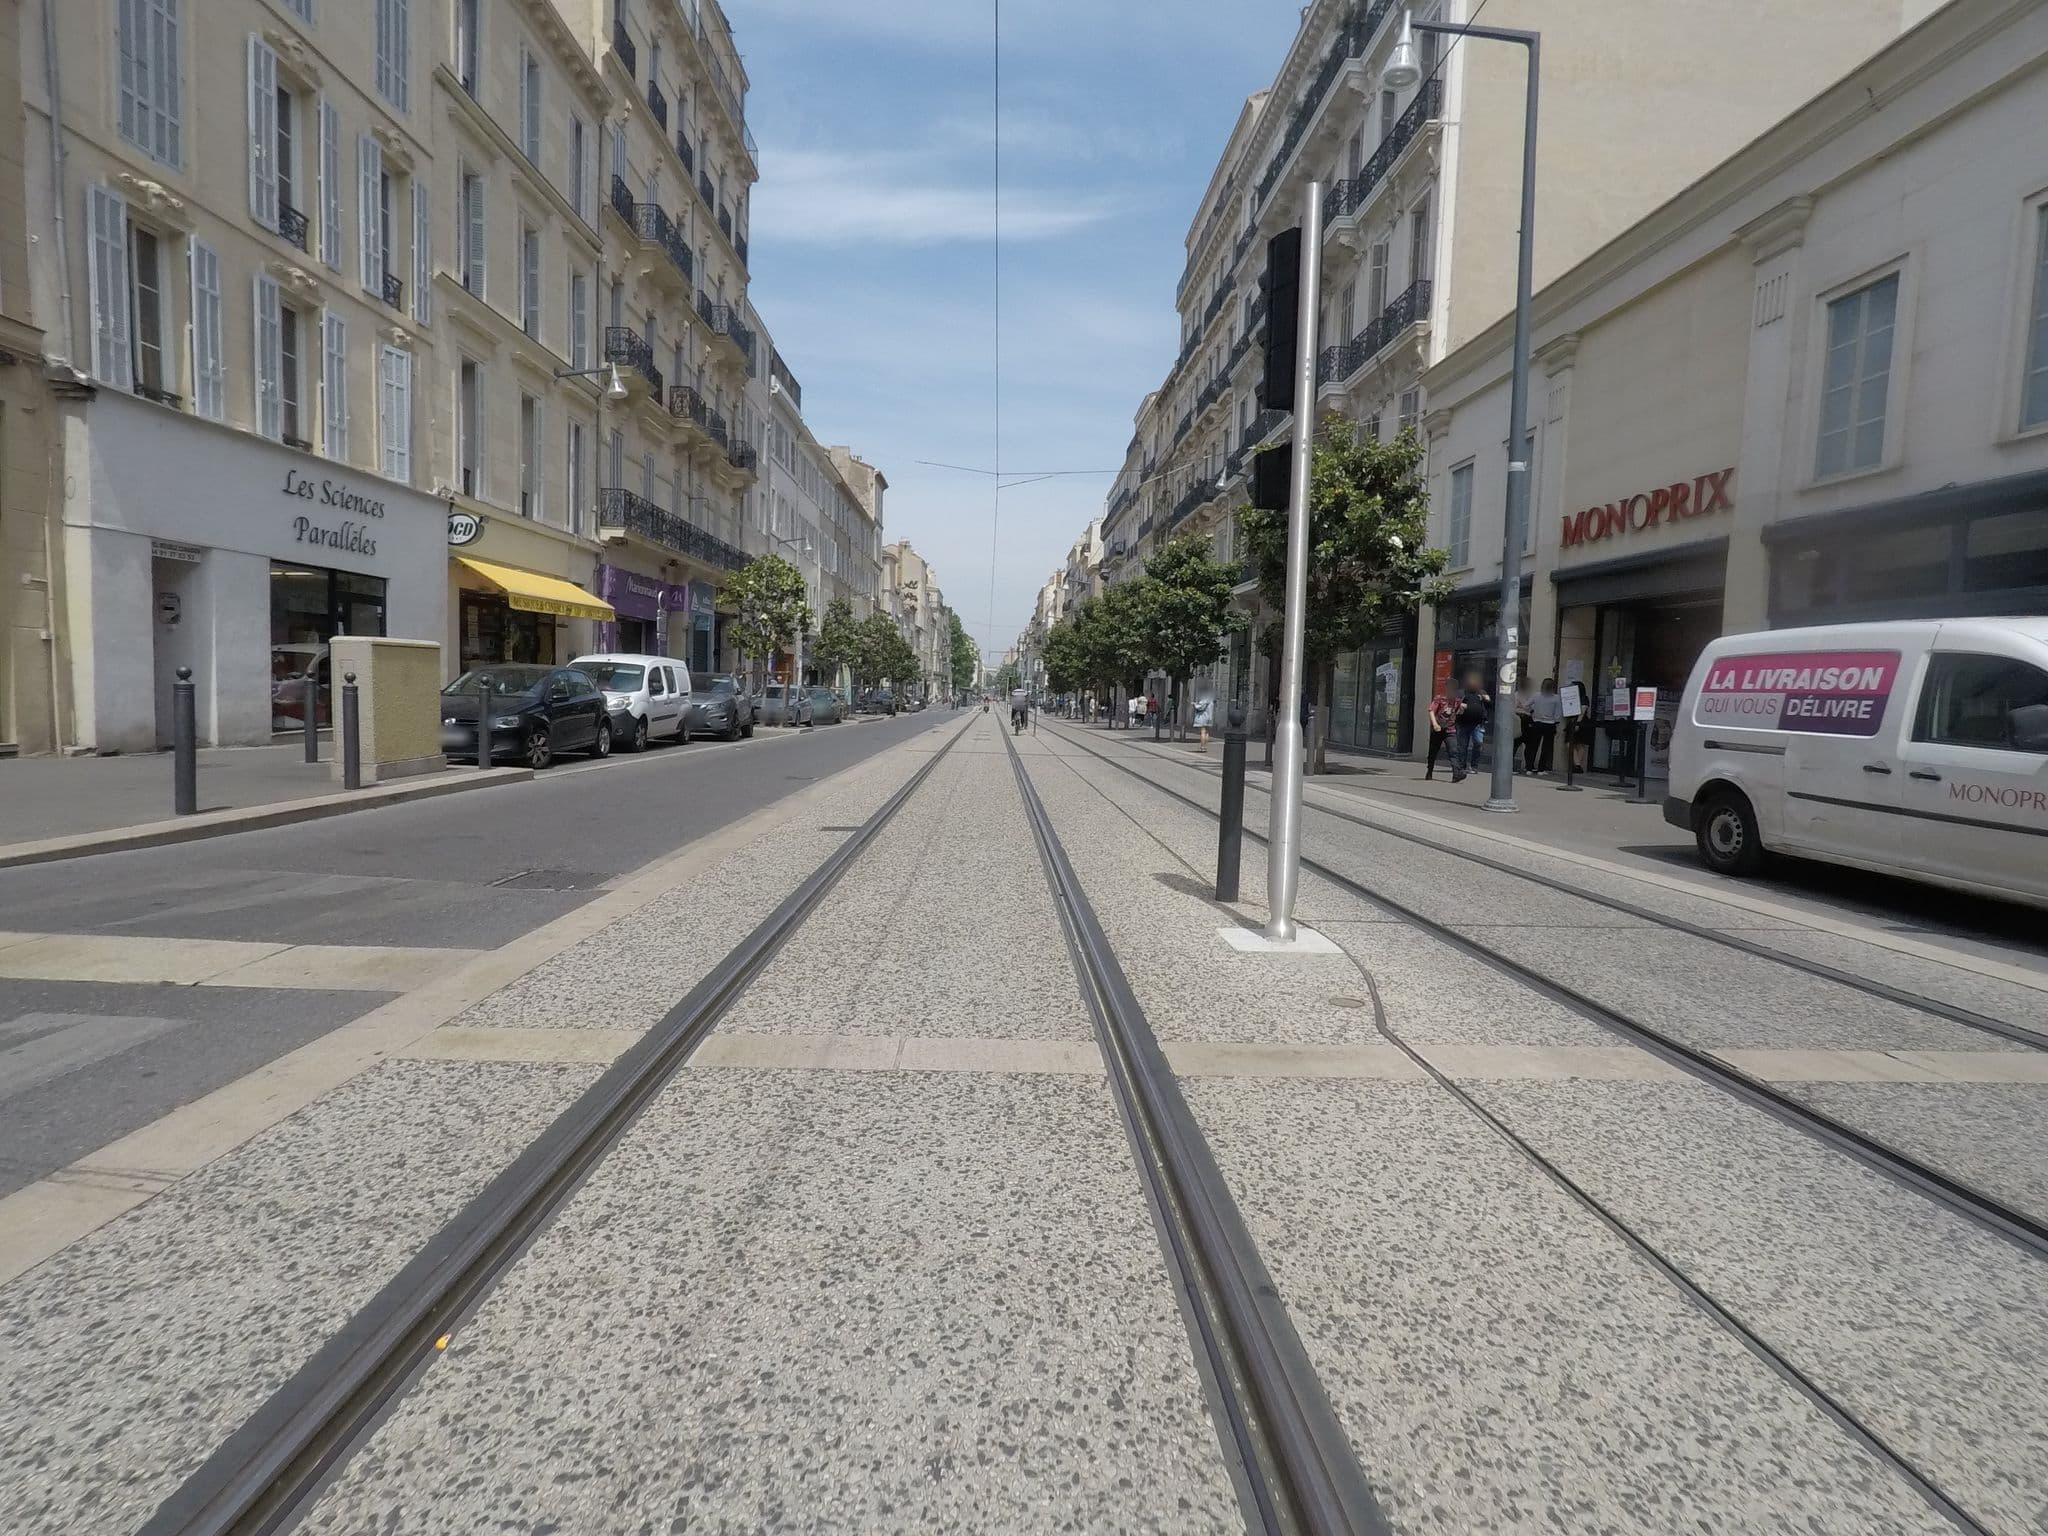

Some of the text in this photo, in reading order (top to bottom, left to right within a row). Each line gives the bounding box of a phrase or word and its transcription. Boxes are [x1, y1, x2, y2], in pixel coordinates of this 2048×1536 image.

[283, 470, 384, 518] Les Sciences
[1560, 467, 1735, 549] MONOPRIX
[1710, 666, 1884, 691] LA LIVRAISON
[1704, 694, 1873, 719] QUI VOUS DÉLIVRE
[1949, 782, 2047, 811] MONOPR
